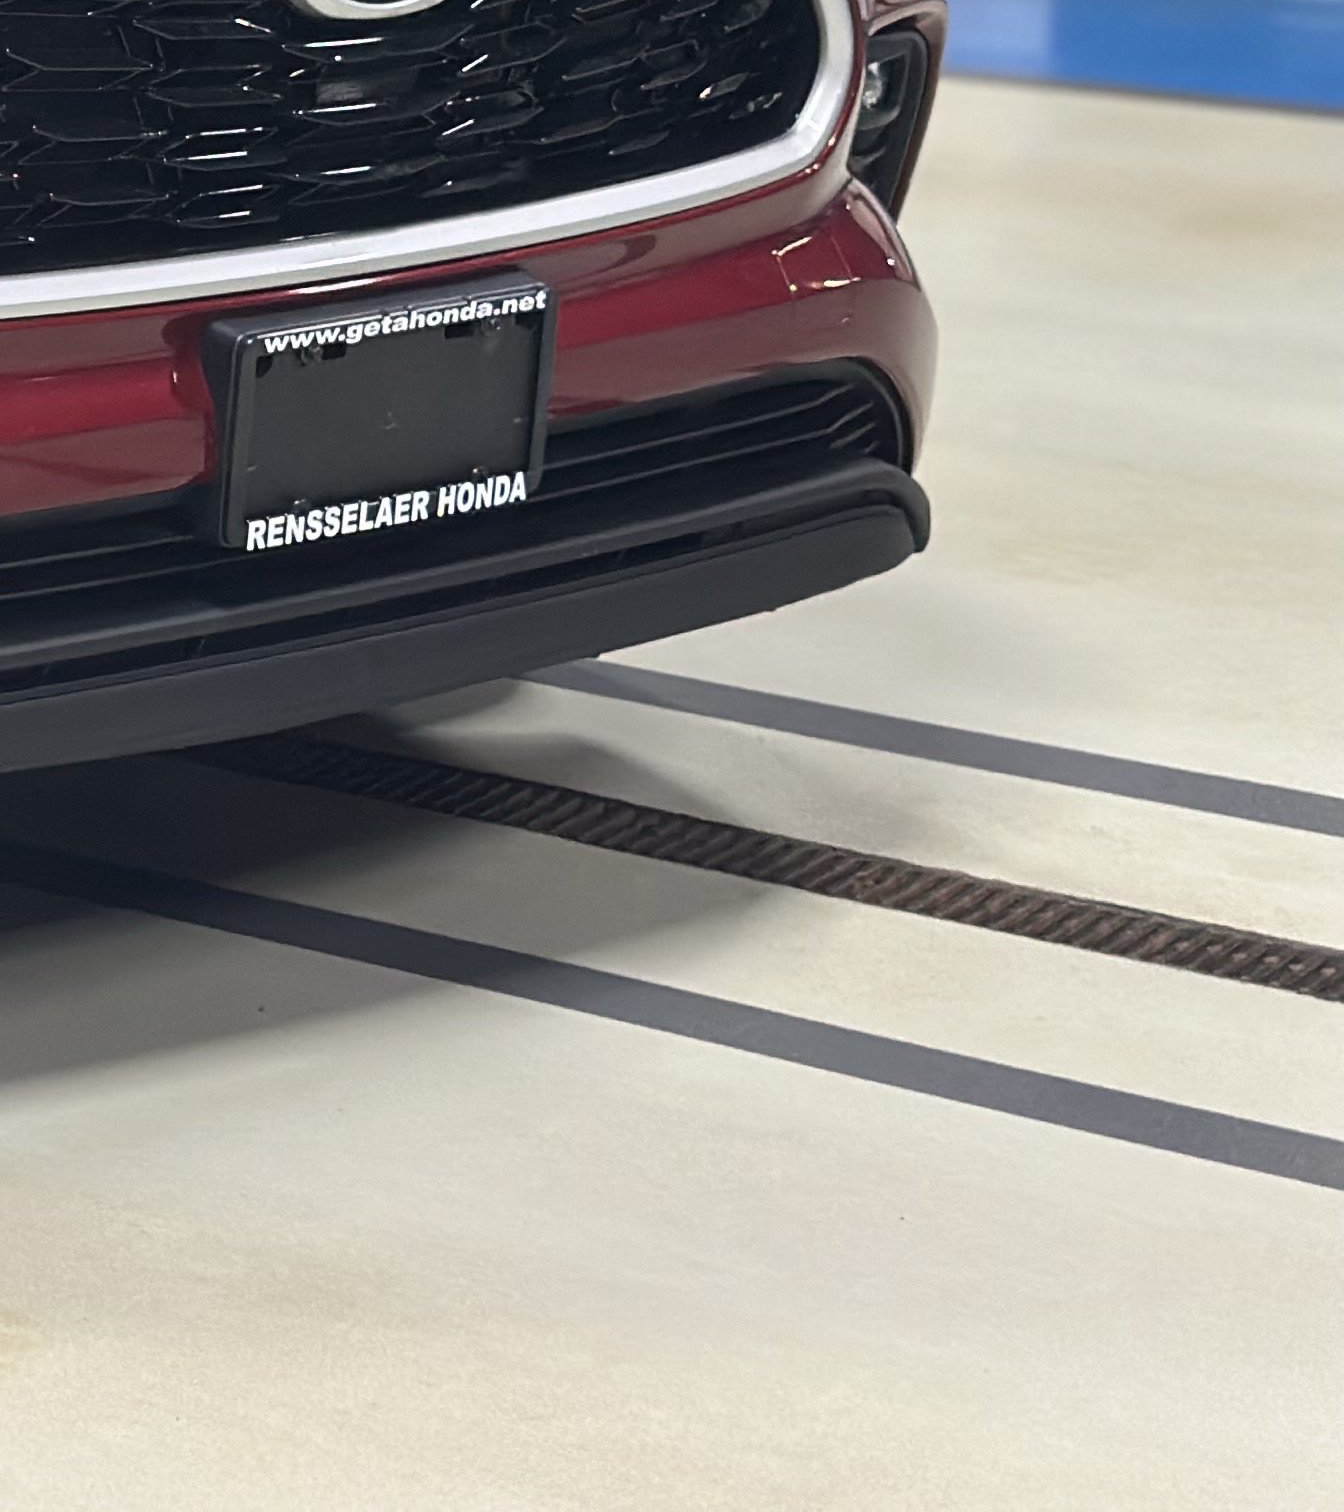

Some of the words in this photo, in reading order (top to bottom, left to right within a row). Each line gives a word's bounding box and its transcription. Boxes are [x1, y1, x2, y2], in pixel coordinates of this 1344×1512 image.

[265, 290, 546, 353] www.getahonda.net
[246, 490, 429, 551] RENSSELAER
[437, 472, 526, 516] HONDA
